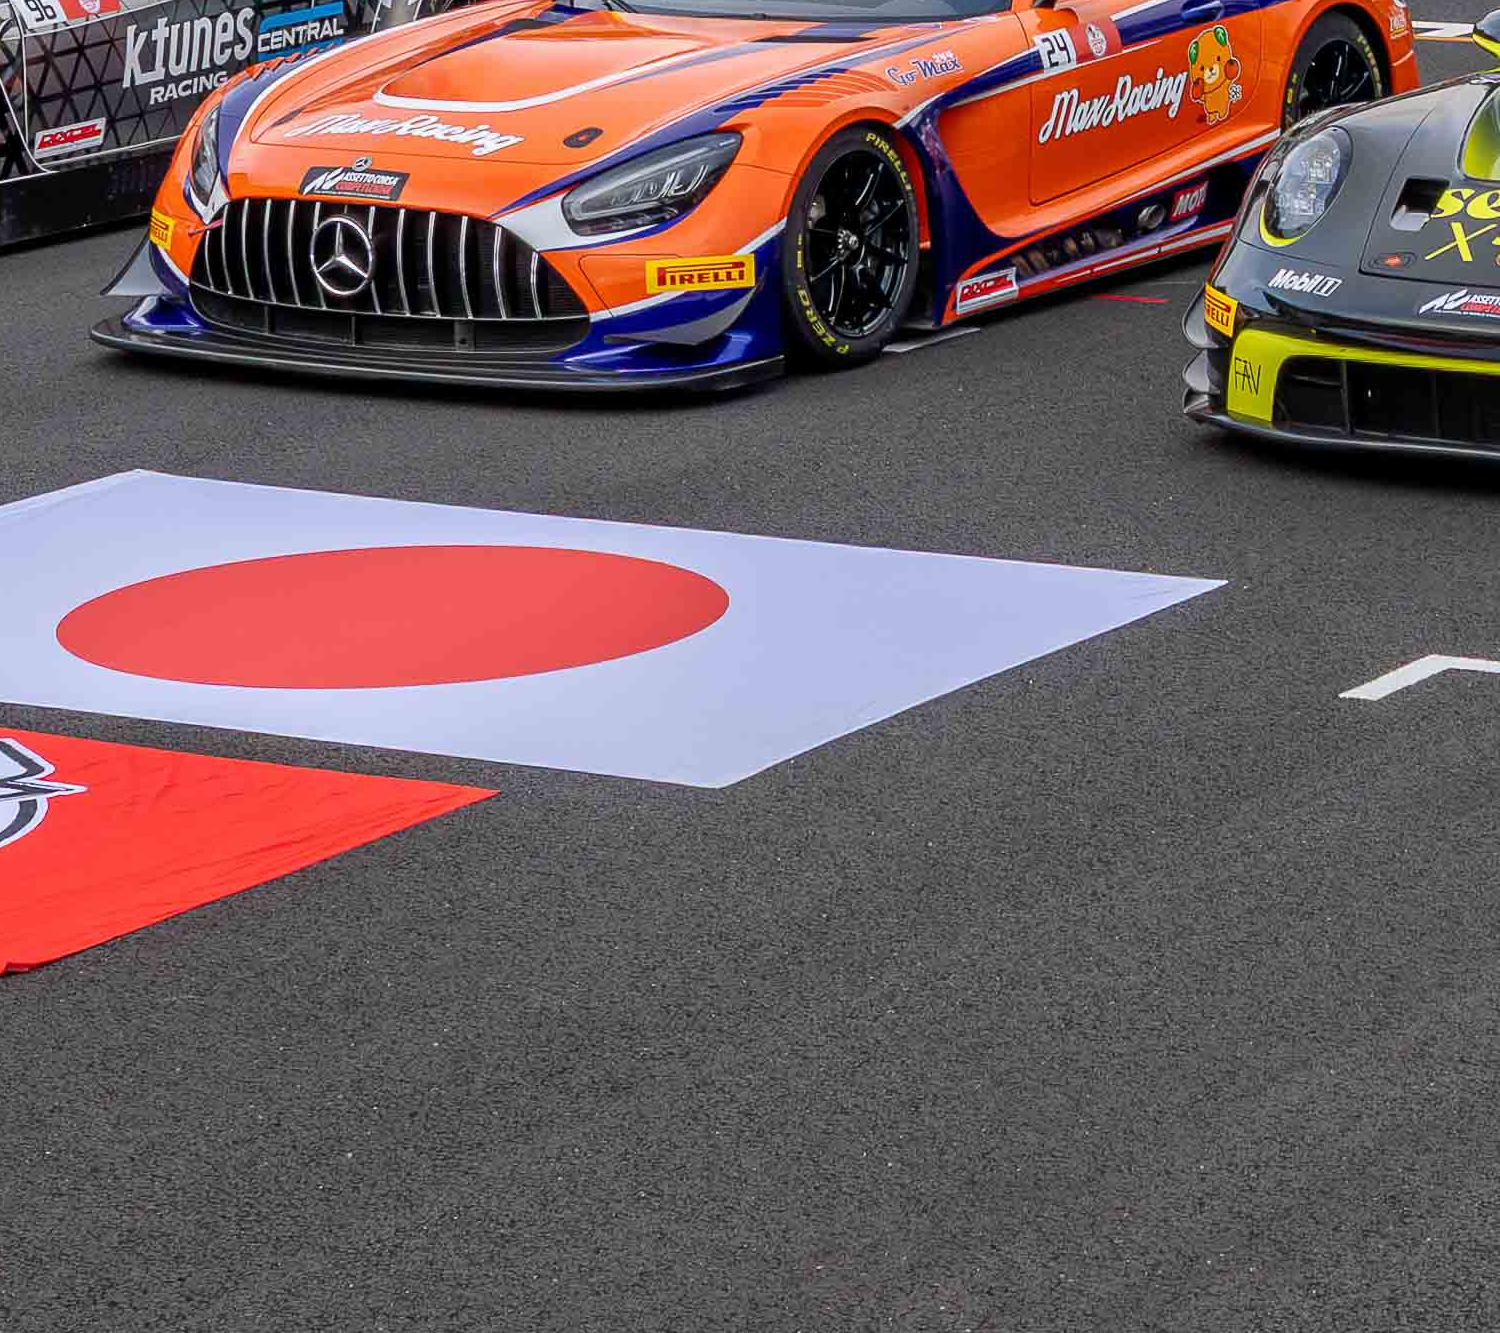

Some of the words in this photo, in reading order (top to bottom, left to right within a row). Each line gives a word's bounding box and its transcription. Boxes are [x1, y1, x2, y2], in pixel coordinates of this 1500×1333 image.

[122, 5, 256, 90] ktunes
[256, 16, 345, 54] CENTRAL
[1041, 36, 1073, 69] 24
[148, 71, 230, 107] RACING
[656, 261, 746, 287] PIRELLI
[1268, 268, 1322, 295] Mobil
